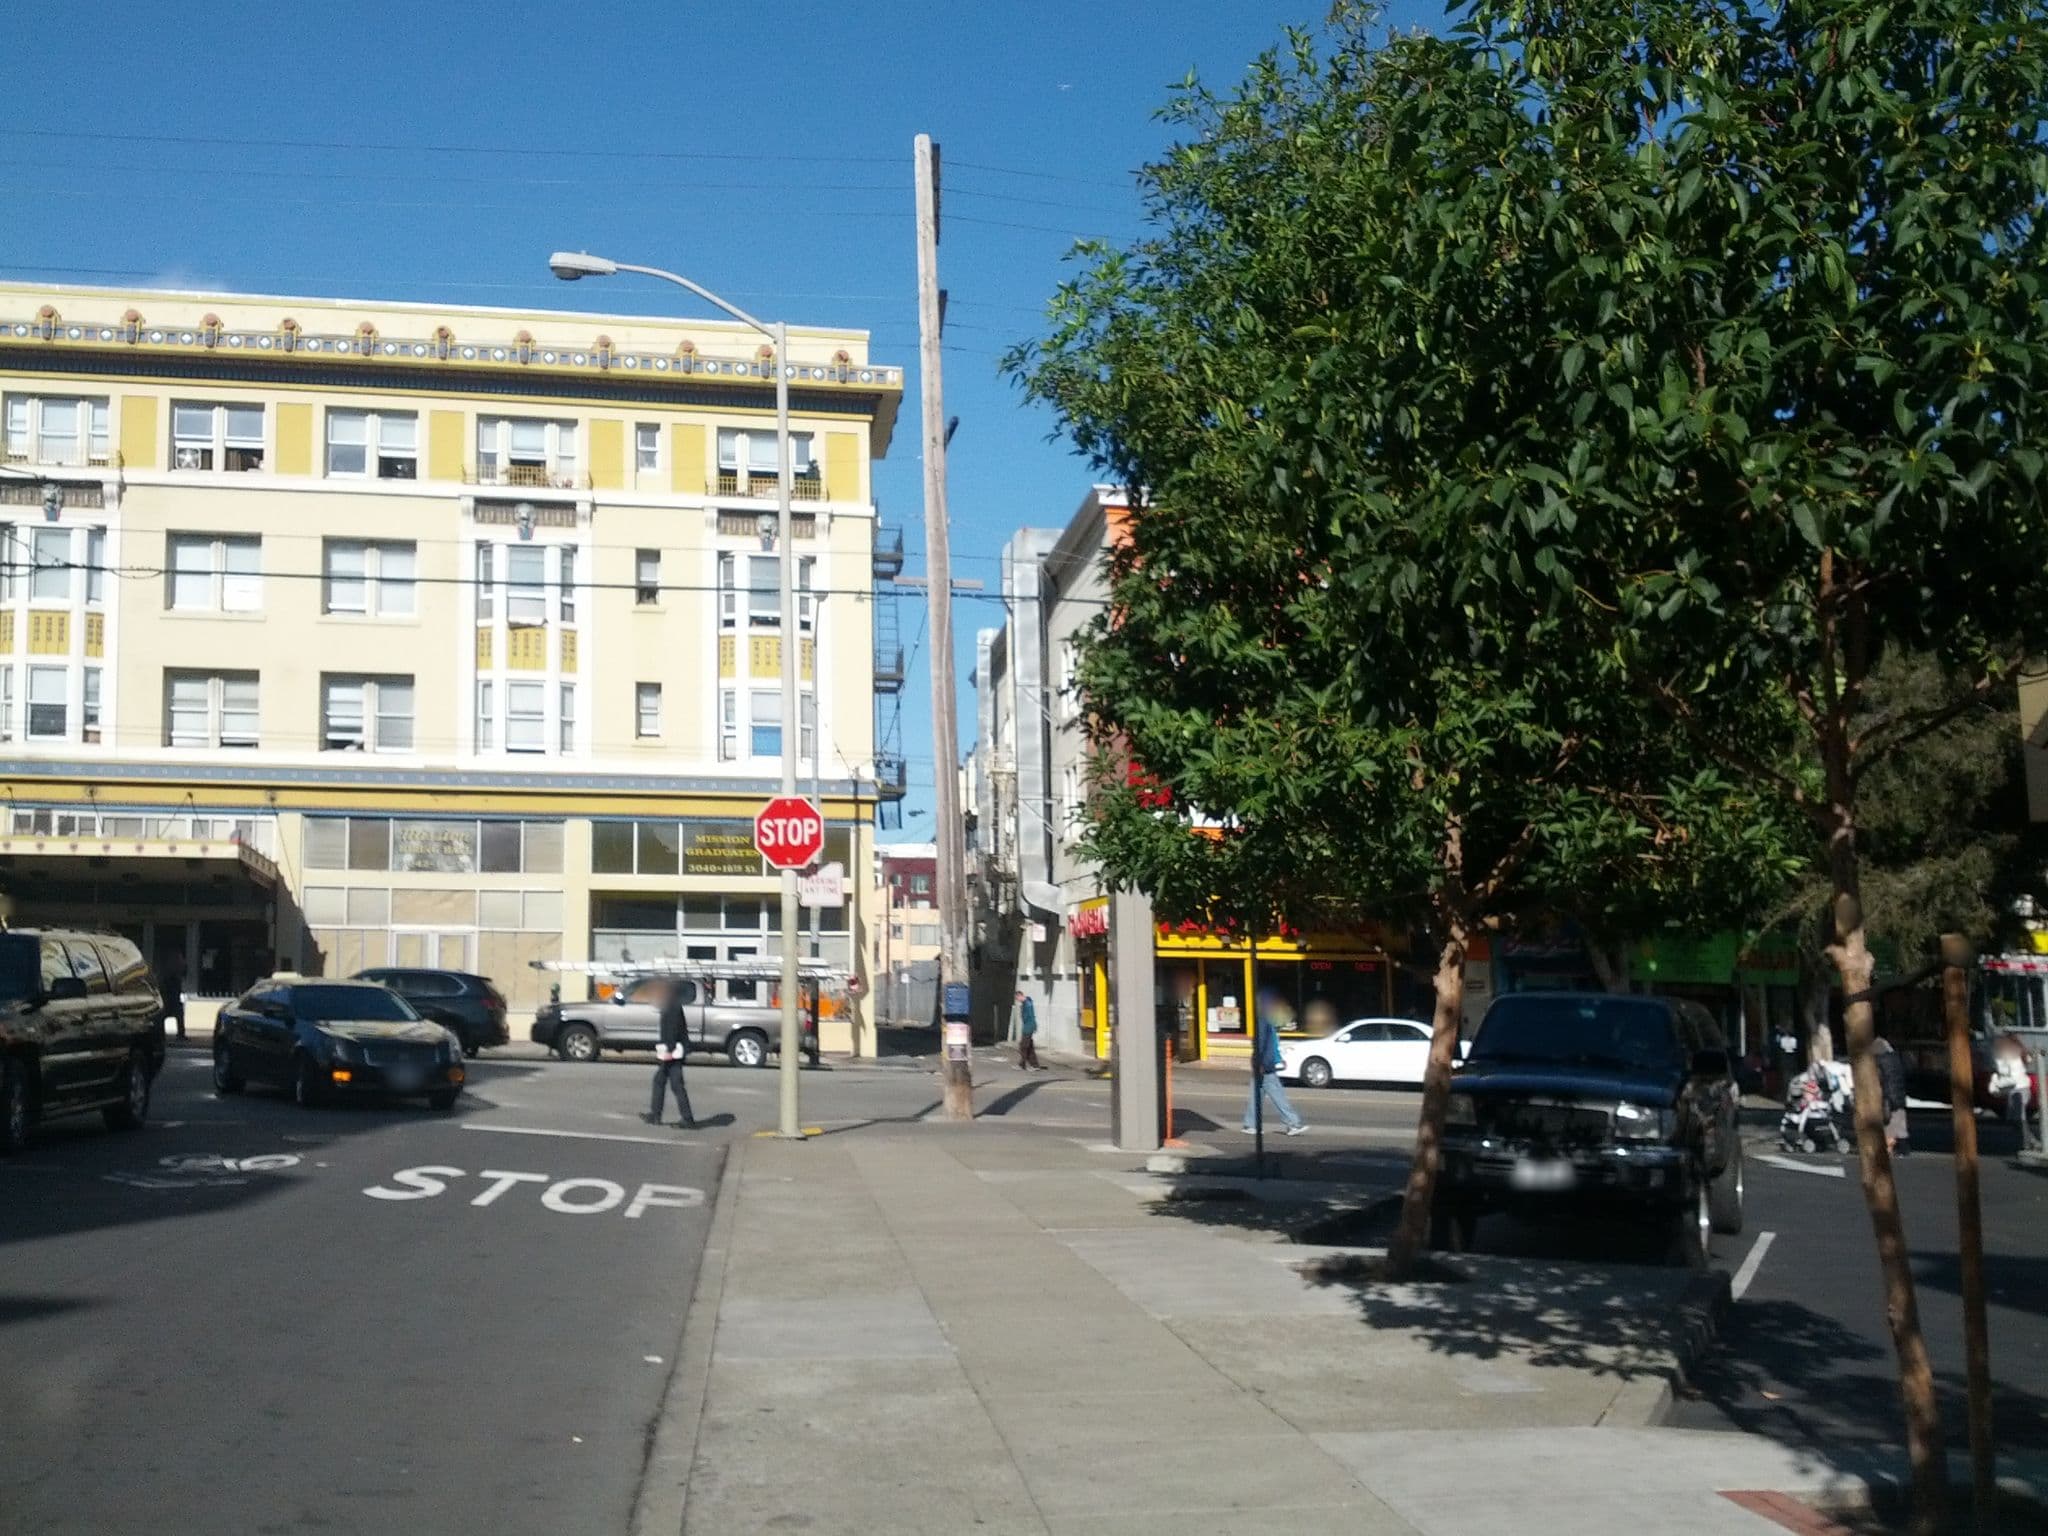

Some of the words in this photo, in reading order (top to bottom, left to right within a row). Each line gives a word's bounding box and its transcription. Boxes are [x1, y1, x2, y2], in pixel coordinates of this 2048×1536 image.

[695, 834, 751, 843] MISSION
[760, 818, 818, 846] STOP
[363, 1165, 705, 1218] STOP
